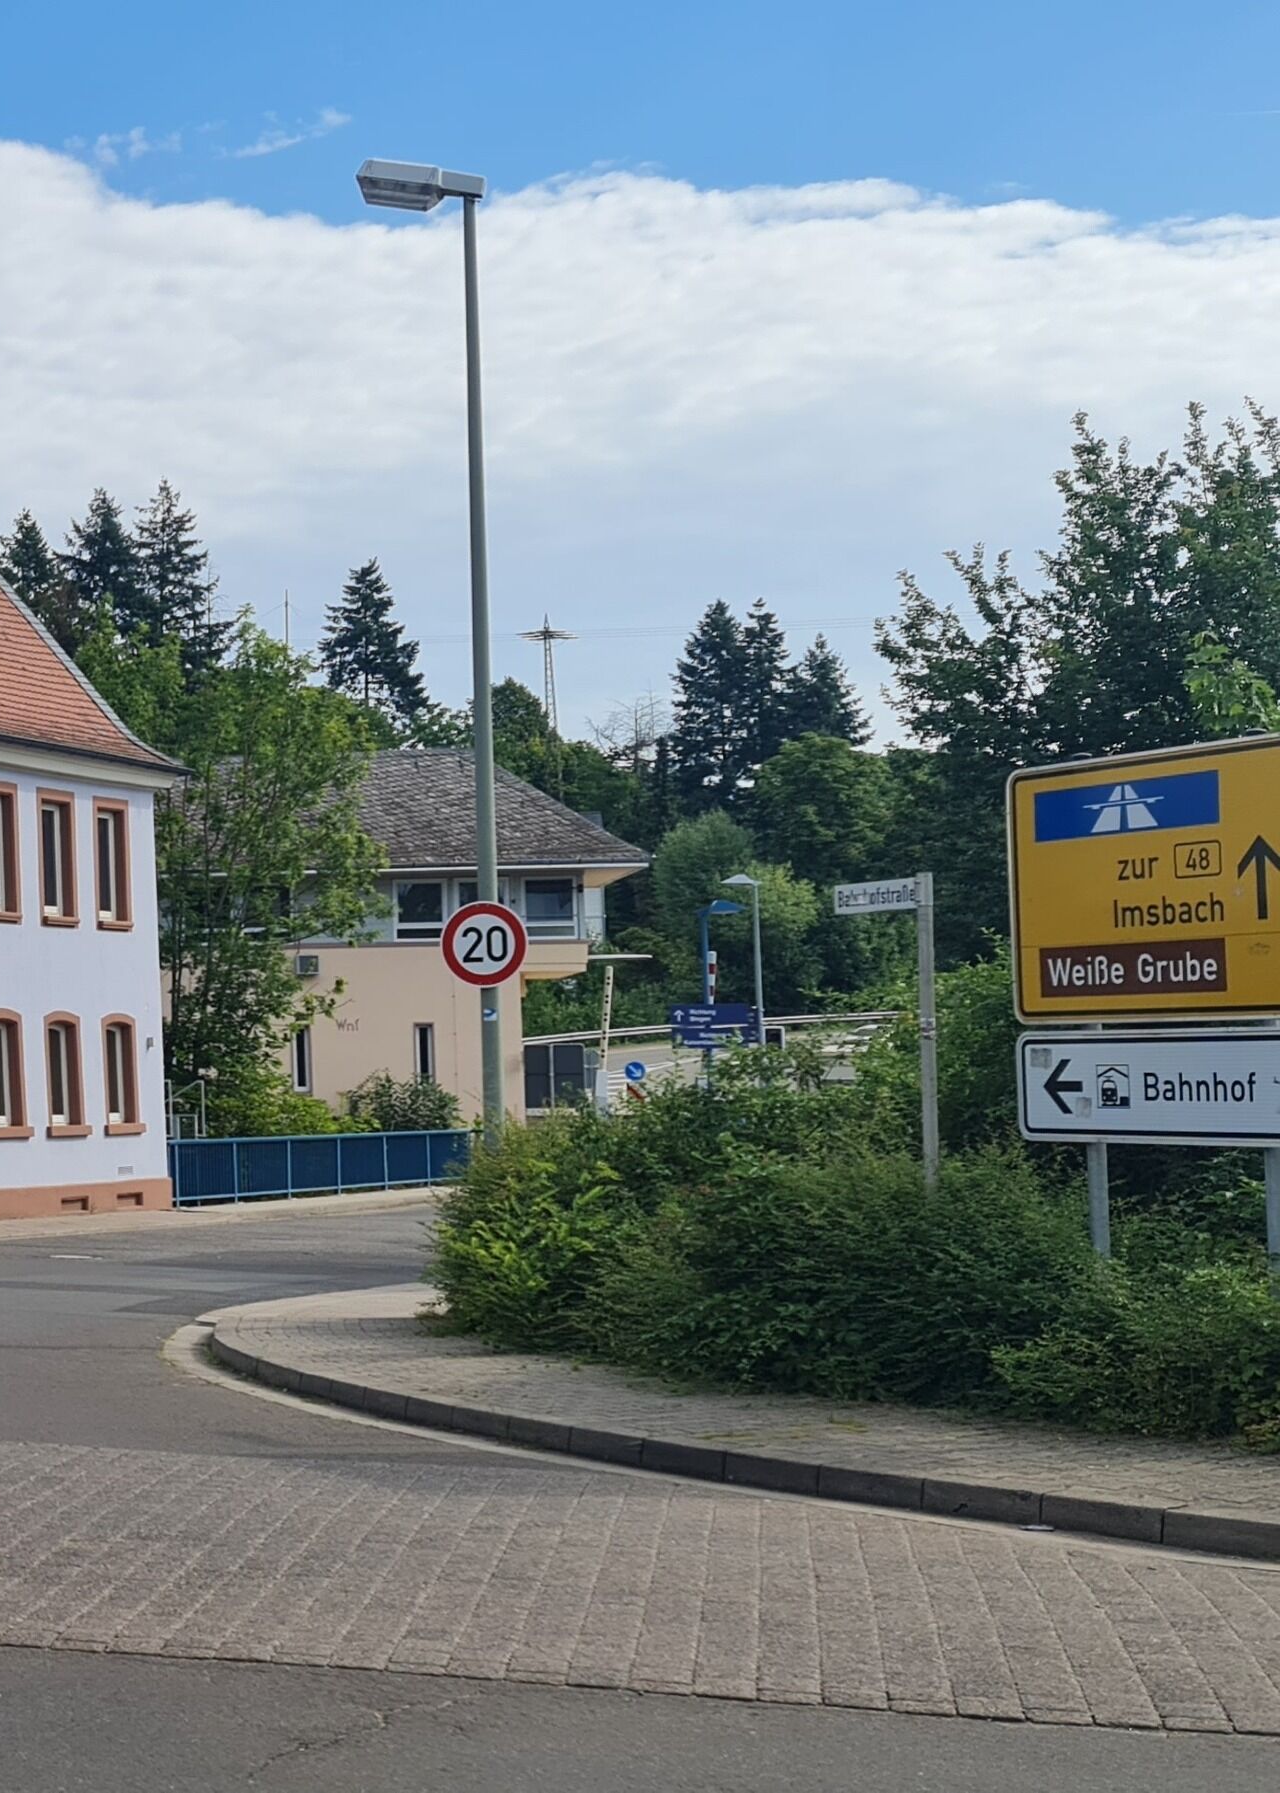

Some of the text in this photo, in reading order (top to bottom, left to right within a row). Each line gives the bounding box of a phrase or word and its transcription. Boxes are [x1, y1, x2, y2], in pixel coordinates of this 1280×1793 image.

[1117, 848, 1210, 882] zur 48
[1113, 891, 1225, 929] Imsbach
[461, 925, 509, 963] 20
[1048, 951, 1218, 987] Weiße Grube
[1144, 1071, 1256, 1103] Bahnhof
